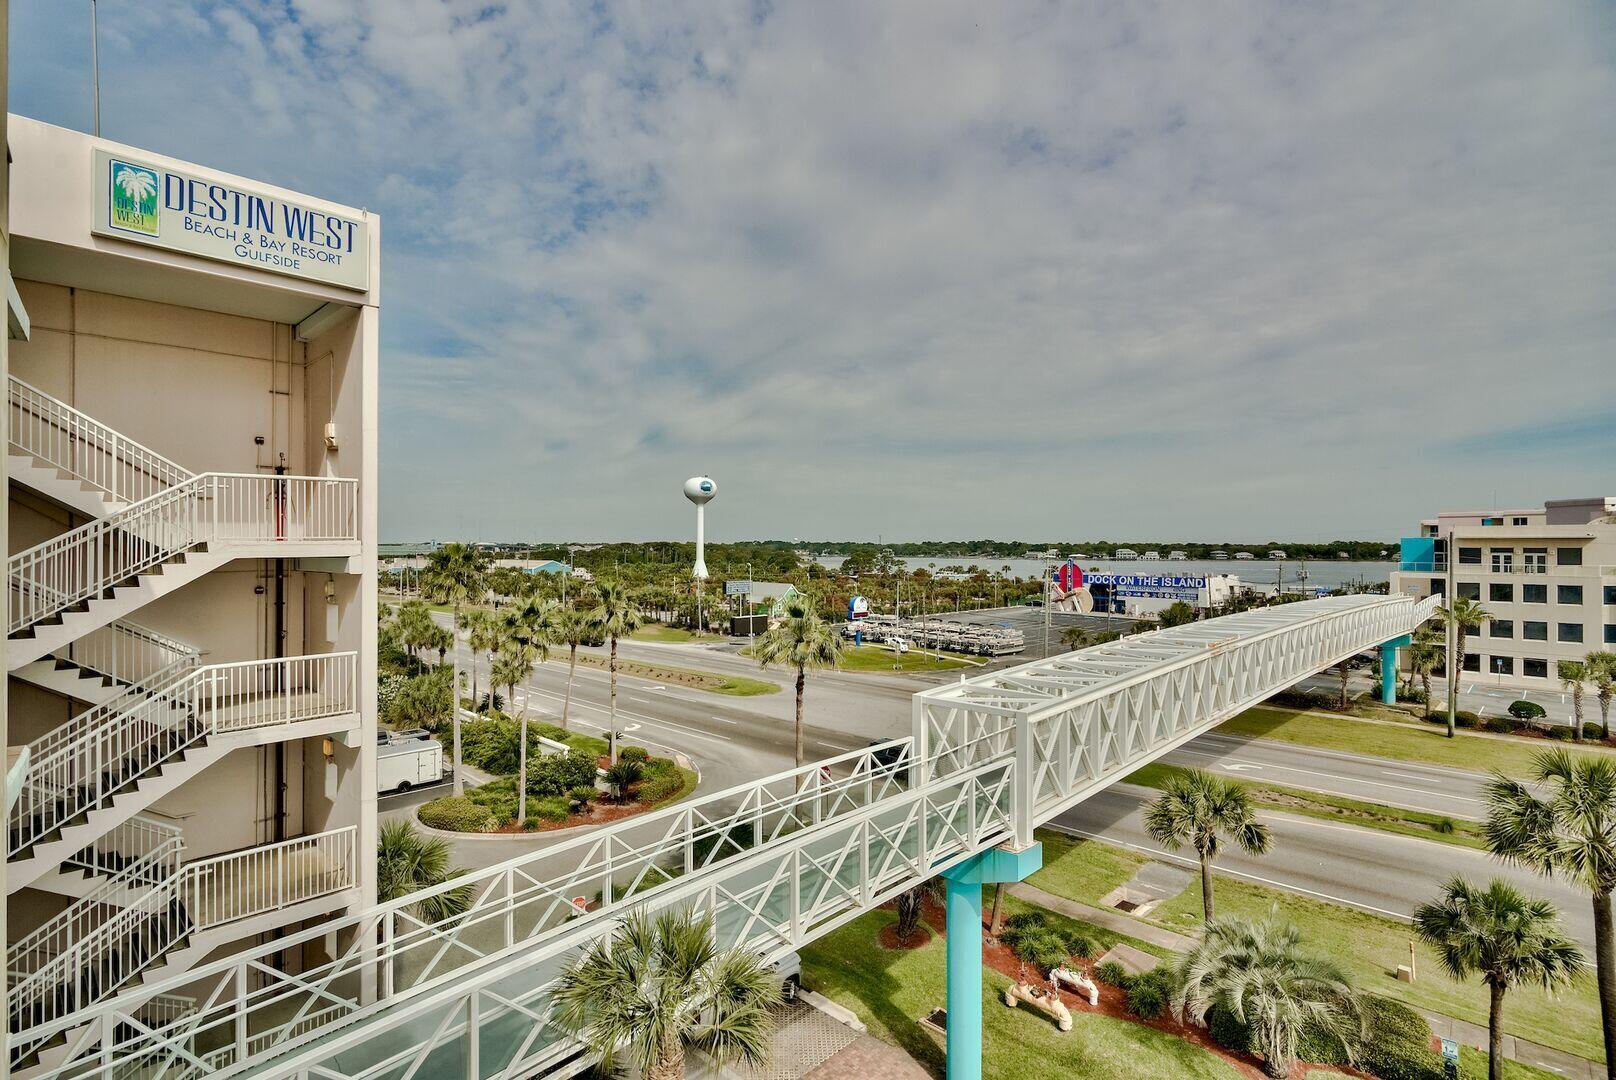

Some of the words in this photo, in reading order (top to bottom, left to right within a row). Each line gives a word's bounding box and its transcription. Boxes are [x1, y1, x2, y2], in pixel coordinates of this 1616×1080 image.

[117, 209, 144, 226] WEST
[165, 173, 274, 234] DESTIN
[281, 203, 358, 253] WEST
[184, 216, 237, 242] BEACH
[242, 232, 253, 246] &
[260, 236, 286, 252] BAY
[292, 242, 343, 266] RESORT
[234, 244, 301, 270] GULFSIDE
[1087, 575, 1117, 585] DOCK
[1119, 576, 1134, 585] ON
[1138, 576, 1159, 586] THE
[1161, 577, 1204, 588] ISLAND
